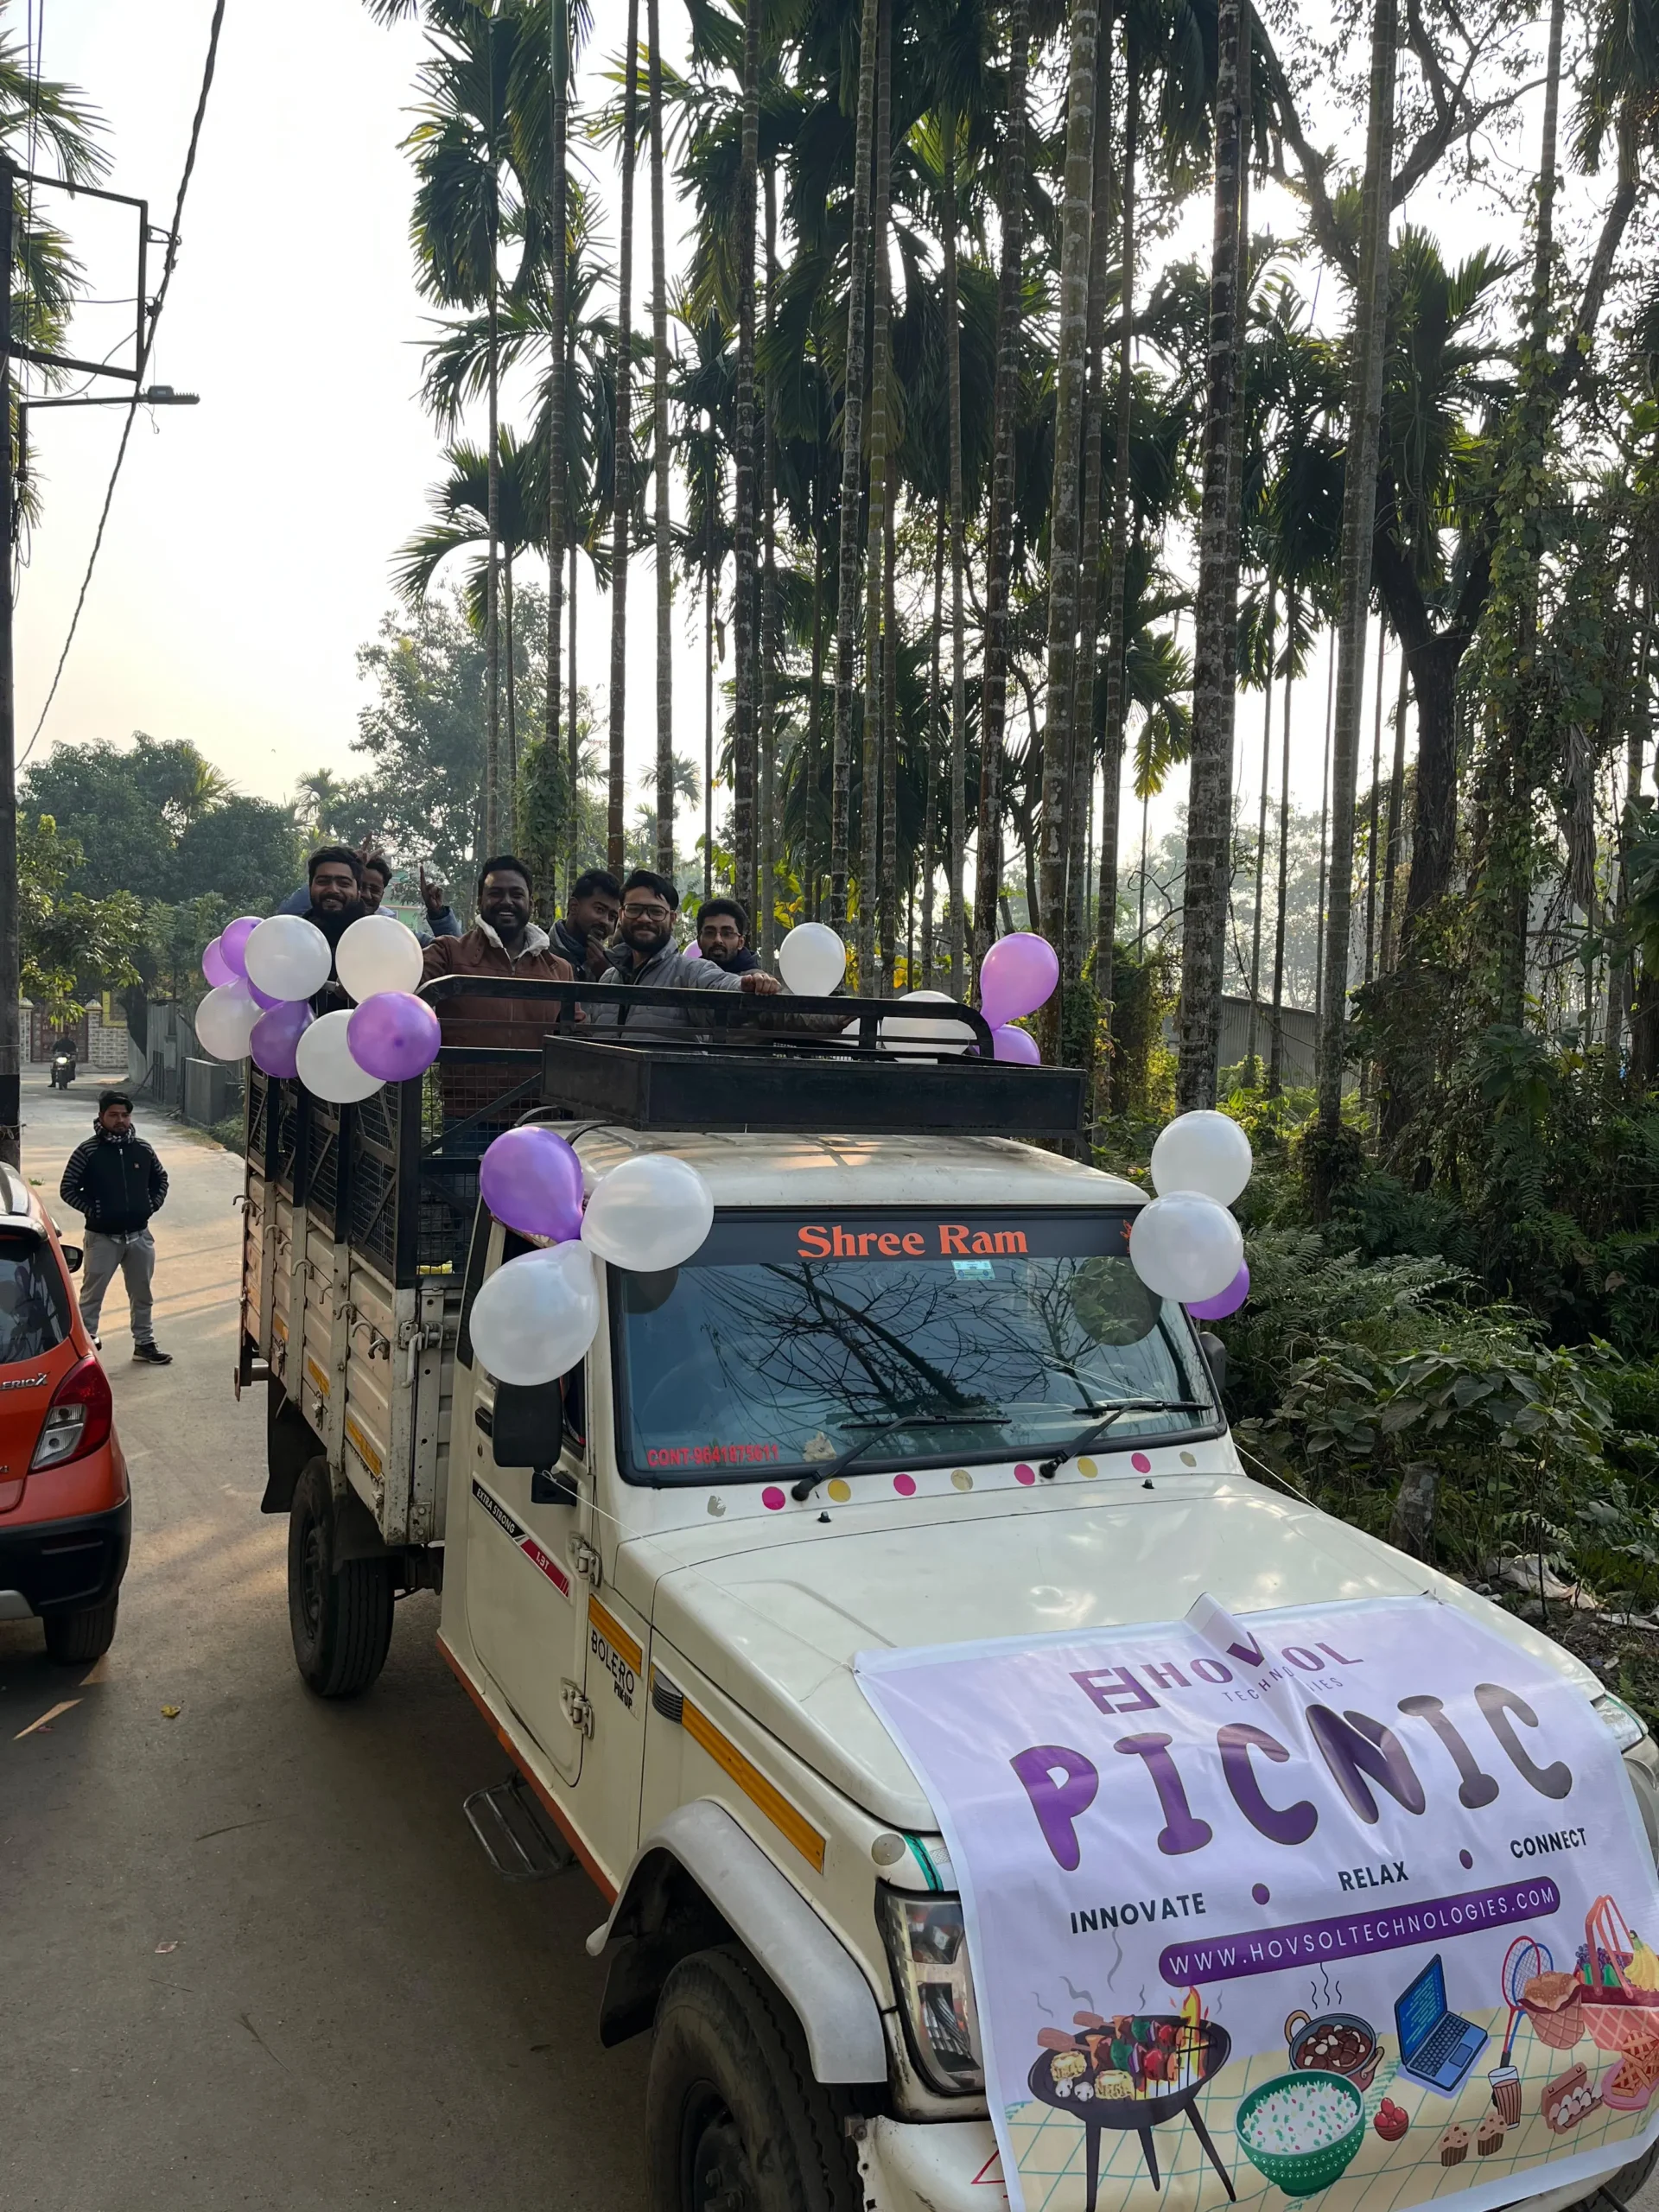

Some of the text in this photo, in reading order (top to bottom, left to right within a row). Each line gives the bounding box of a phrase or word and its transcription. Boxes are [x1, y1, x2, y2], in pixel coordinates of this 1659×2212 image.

[798, 1224, 1028, 1258] Shree Ram
[476, 1488, 516, 1534] EXTRA STRONG
[536, 1551, 550, 1570] 1.3T
[591, 1629, 635, 1694] BOLERO
[1139, 1631, 1365, 1690] HOVOL
[1009, 1682, 1573, 1872] PICNIC
[1071, 1827, 1587, 1935] INNOVATE RELAX CONNECT
[1168, 1886, 1554, 1975] WWW.HOVSOLTECHNOLOGIES.COM
